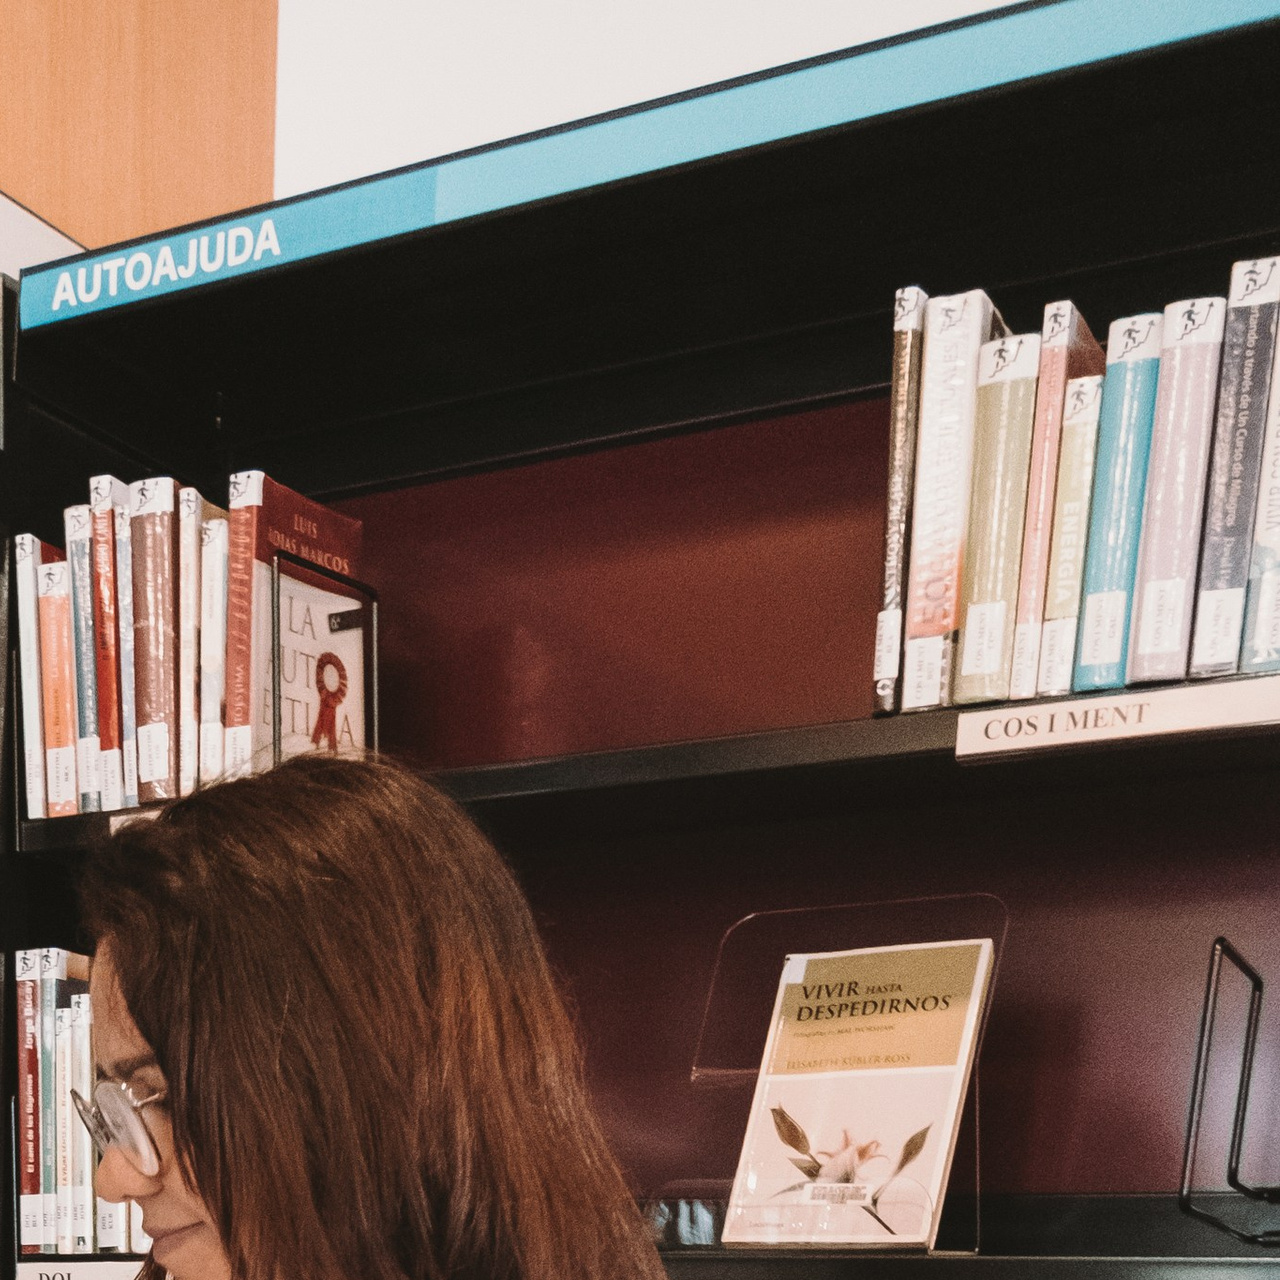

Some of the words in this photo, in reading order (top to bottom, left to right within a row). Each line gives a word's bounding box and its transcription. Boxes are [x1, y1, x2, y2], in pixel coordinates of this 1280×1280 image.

[52, 219, 281, 311] AUTOAJUDA
[984, 717, 1039, 742] COS
[1047, 712, 1061, 734] I
[1065, 703, 1151, 733] MENT
[24, 981, 35, 1015] Bucay
[802, 981, 859, 999] VIVIR
[865, 984, 902, 994] HASTA
[796, 995, 952, 1022] DESPEDIRNOS
[24, 1020, 34, 1049] Jorge
